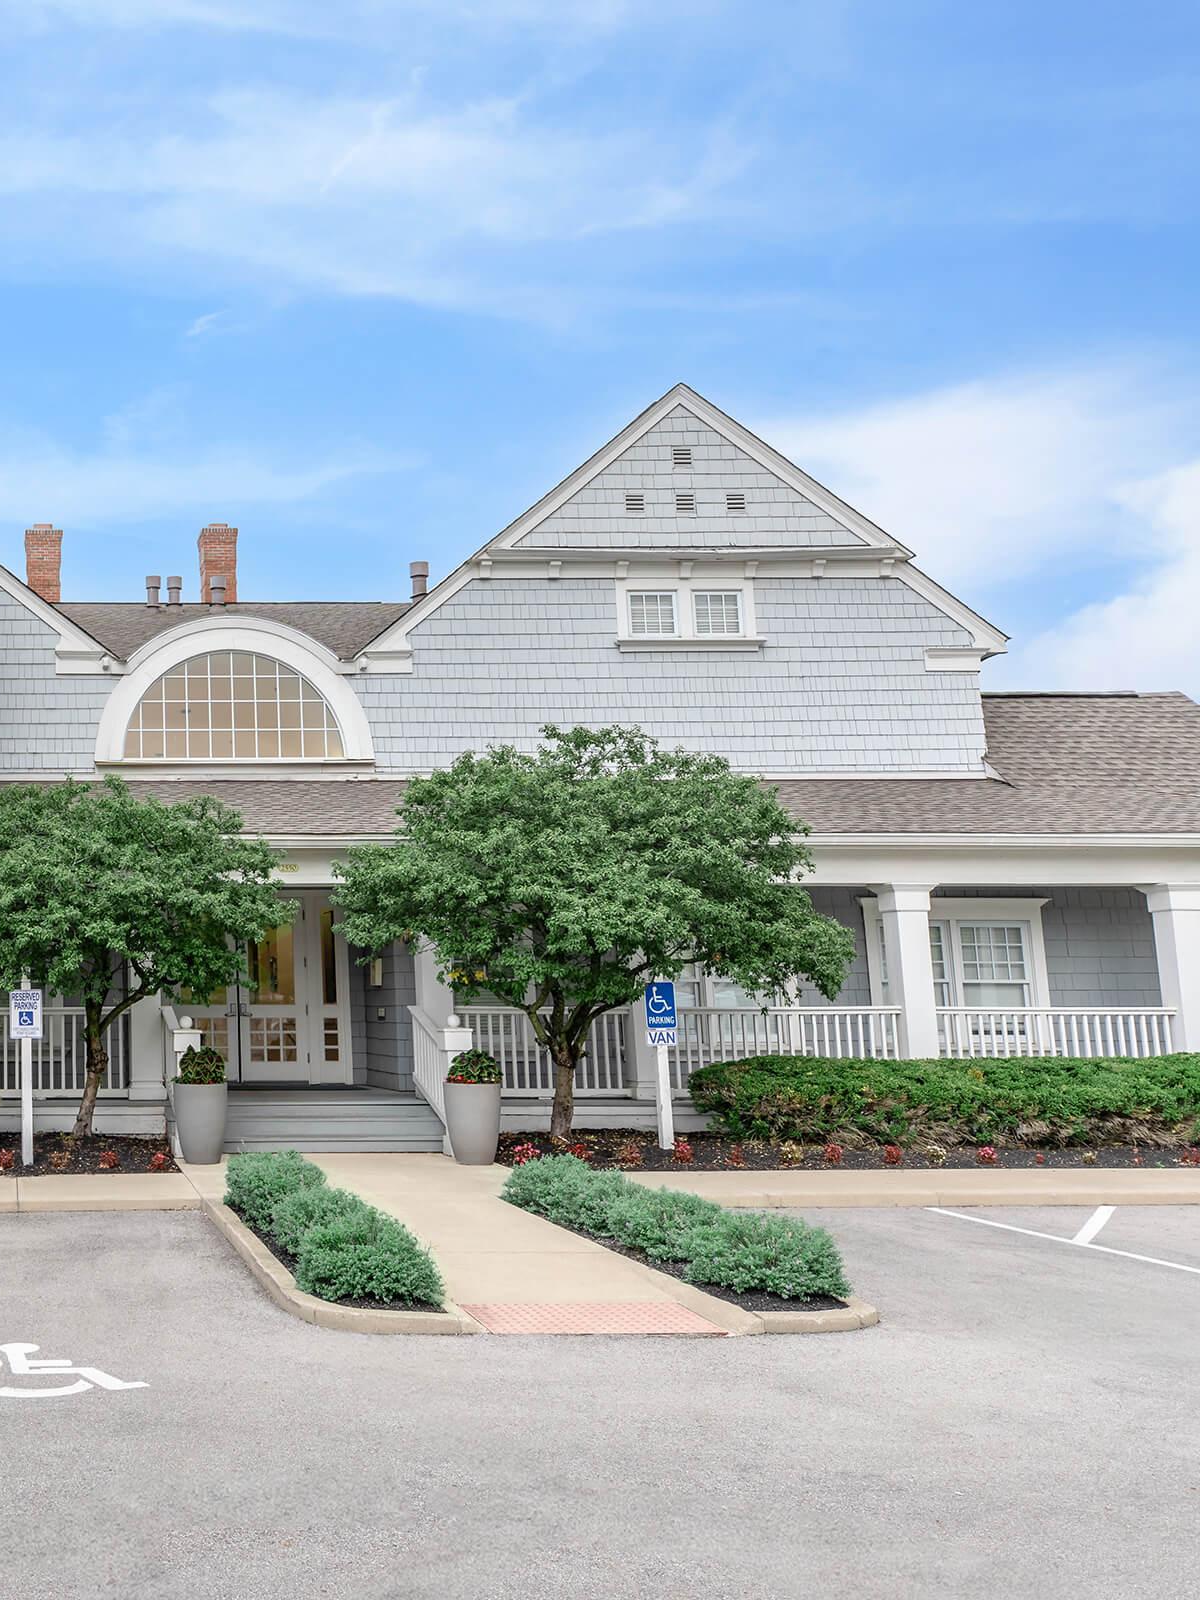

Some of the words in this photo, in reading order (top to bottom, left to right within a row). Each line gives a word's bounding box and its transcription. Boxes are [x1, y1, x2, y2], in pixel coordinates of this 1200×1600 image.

[12, 992, 40, 1001] RESERVED
[14, 1002, 38, 1010] PARKING
[648, 1016, 675, 1025] PARKING
[649, 1032, 675, 1044] VAN
